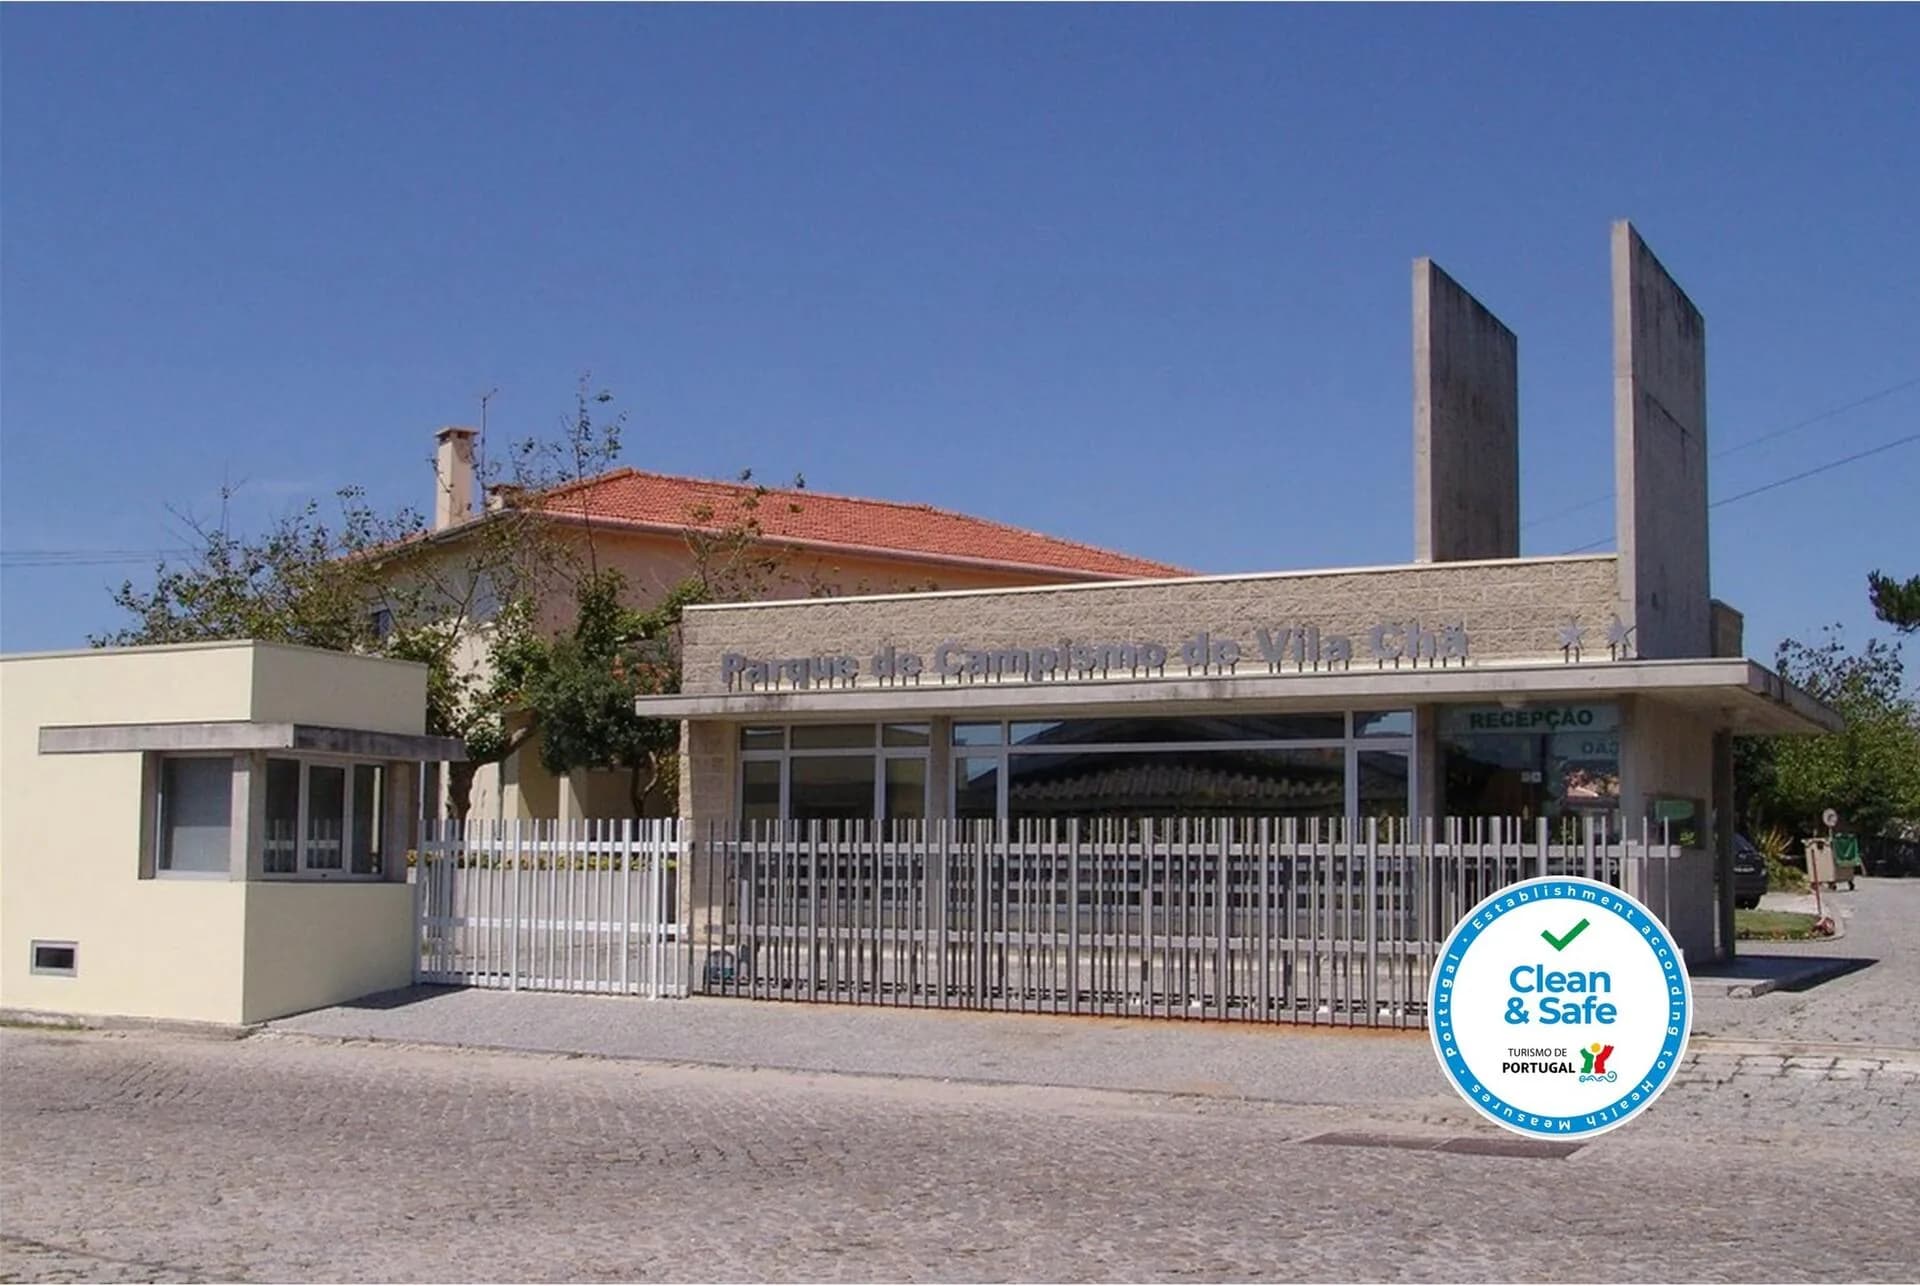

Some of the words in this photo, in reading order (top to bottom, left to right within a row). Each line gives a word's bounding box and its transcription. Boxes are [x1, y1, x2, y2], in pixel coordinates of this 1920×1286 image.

[720, 650, 859, 689] Parque
[871, 645, 923, 678] de
[934, 637, 1167, 682] Campismo
[1182, 632, 1241, 667] de
[1255, 626, 1352, 662] Vila
[1369, 619, 1468, 659] Chã
[1470, 708, 1593, 730] RECEPÇÃO
